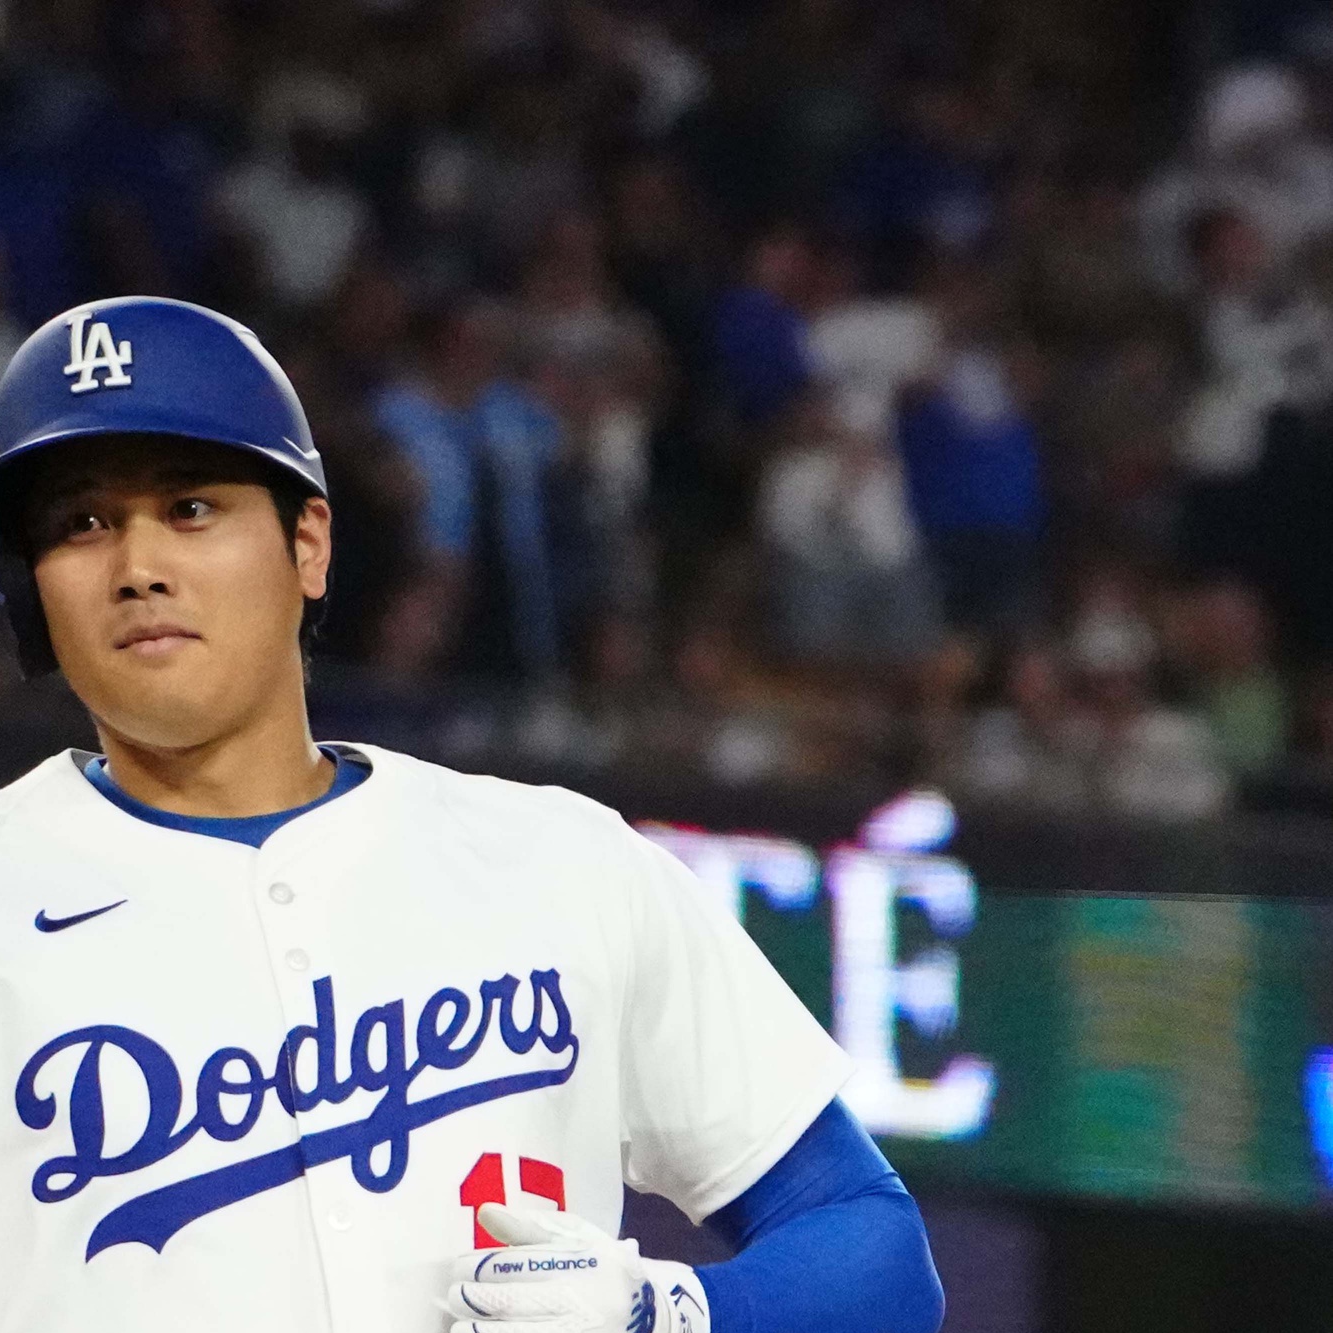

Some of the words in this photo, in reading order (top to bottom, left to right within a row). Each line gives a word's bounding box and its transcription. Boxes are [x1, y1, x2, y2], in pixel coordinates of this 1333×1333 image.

[63, 312, 133, 393] LA
[15, 968, 579, 1205] Dodgers
[493, 1262, 524, 1274] new
[529, 1257, 598, 1272] balance
